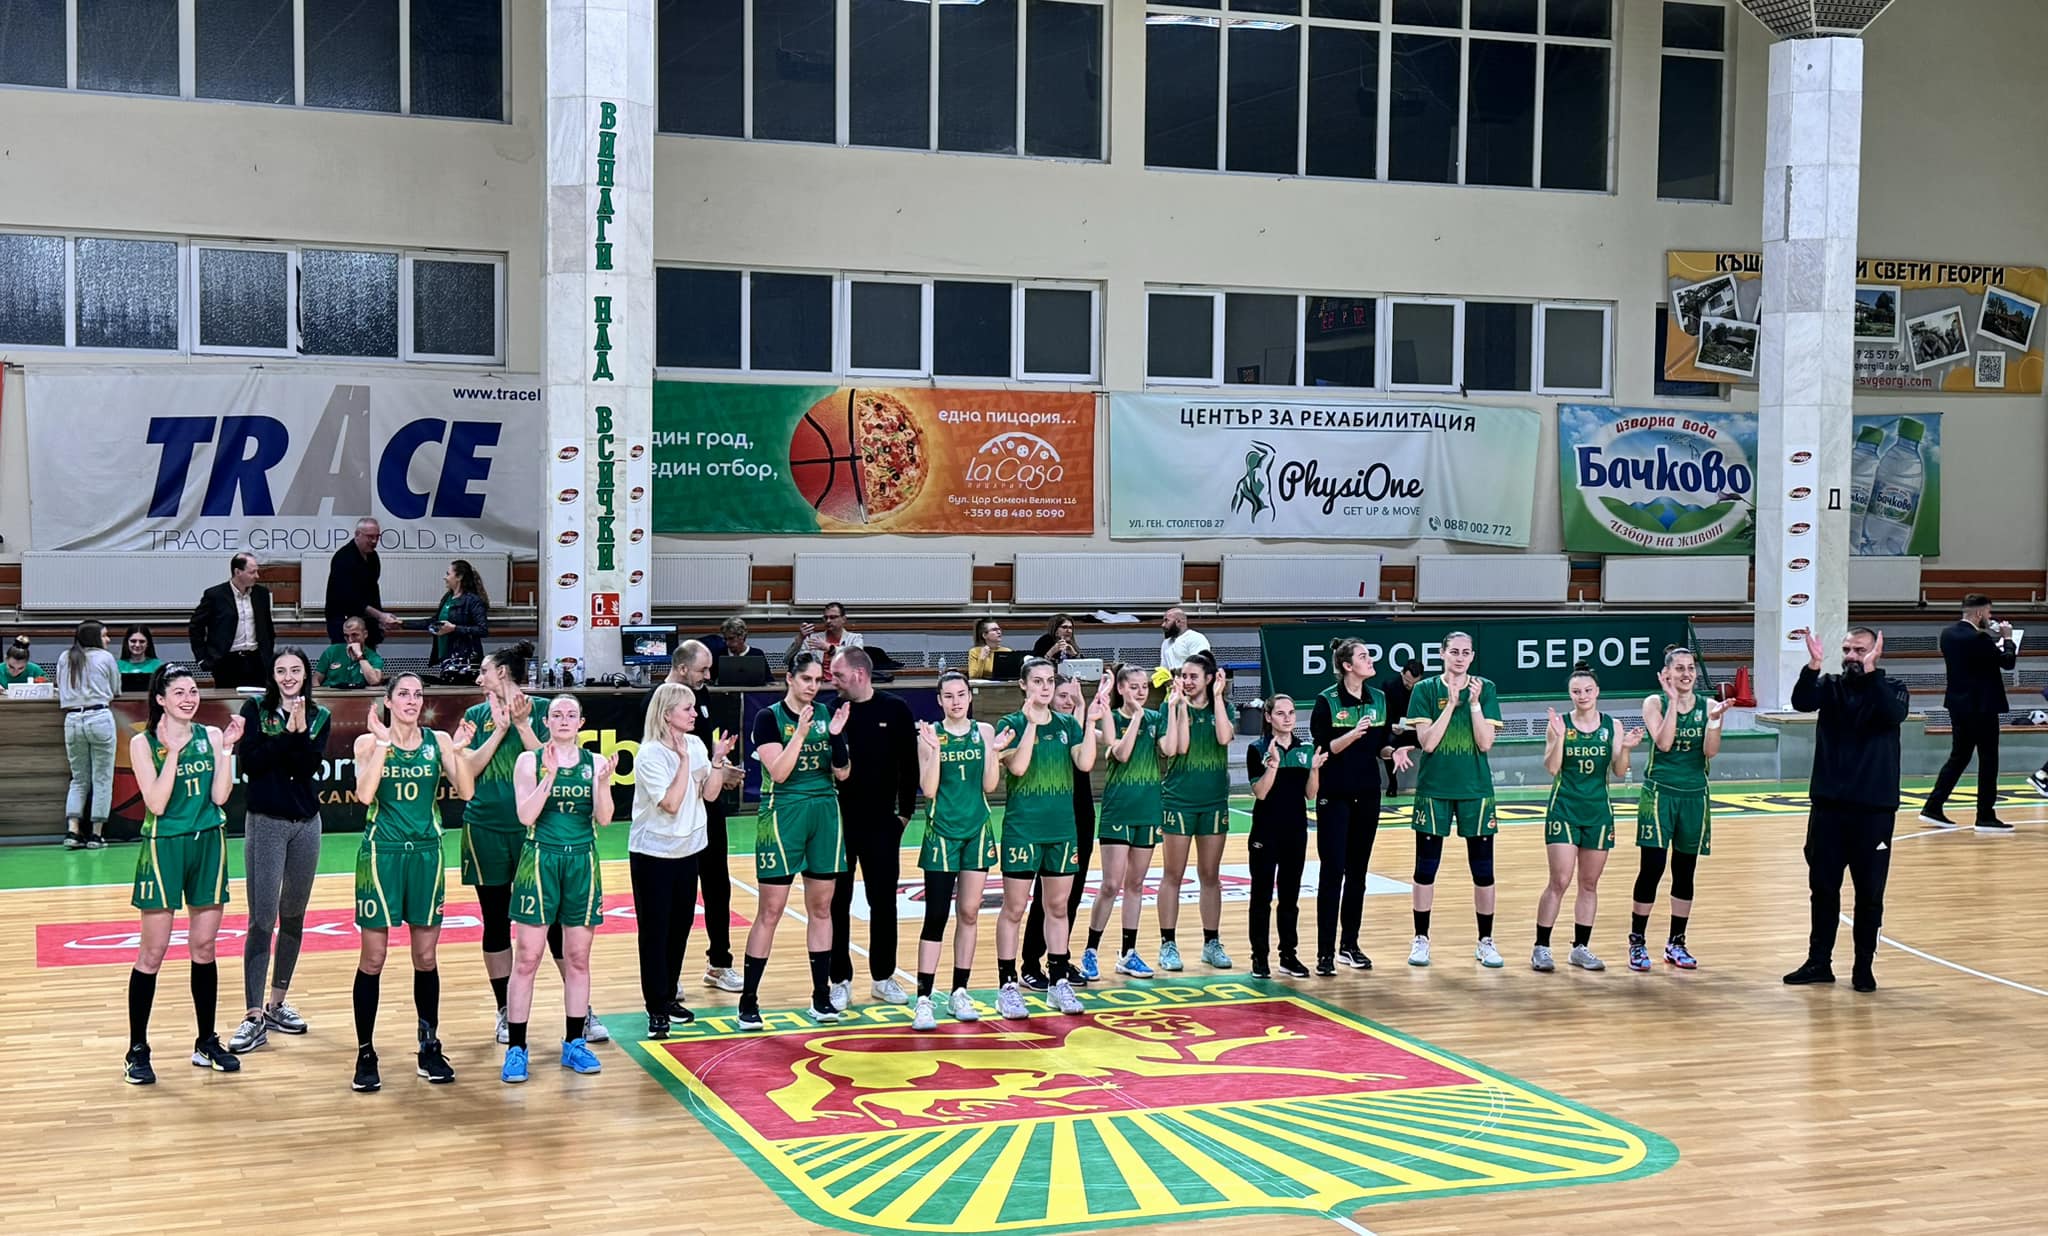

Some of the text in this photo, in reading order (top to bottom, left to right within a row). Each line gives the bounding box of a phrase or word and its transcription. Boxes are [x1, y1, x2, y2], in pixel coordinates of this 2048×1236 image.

[1874, 262, 1931, 281] СВЕТИ
[1937, 265, 2004, 285] ГЕОРГИ
[592, 102, 617, 571] ВИНАГИ НАД ВСИЧКИ
[938, 410, 981, 424] една
[1180, 408, 1476, 432] ЦЕНТЪР ЗА РЕХАБИЛИТАЦИЯ
[1616, 416, 1718, 439] изворна вода
[652, 431, 754, 450] дин град,
[146, 384, 502, 519] TRACE
[706, 458, 778, 481] отбор,
[1577, 446, 1752, 494] Бачково
[1278, 459, 1424, 515] PhysiOne
[948, 495, 1077, 506] бул. Цар Симеон Велики 116
[963, 508, 1065, 518] +359 88 480 5090
[1343, 506, 1422, 516] GET UP & MOVE
[1129, 519, 1225, 528] УЛ. ГЕН. СТОЛЕТОВ 27
[1444, 519, 1512, 536] 0887 002 772
[149, 528, 485, 550] TRACE GROUP OLD PLC
[1609, 519, 1653, 547] избор
[1656, 535, 1674, 547] на
[1517, 636, 1651, 670] БЕРОЕ
[940, 749, 982, 762] BEROE
[1566, 746, 1607, 757] BEROE
[176, 759, 214, 777] EROE
[798, 755, 820, 771] 33
[1578, 759, 1595, 774] 19
[958, 764, 966, 781] 1
[185, 777, 200, 797] 11
[394, 781, 419, 800] 10
[552, 785, 591, 798] EROE
[1163, 810, 1176, 826] 14
[1548, 821, 1562, 836] 19
[1641, 824, 1653, 840] 13
[759, 852, 777, 869] 33
[1008, 847, 1029, 864] 34
[139, 880, 154, 900] 11
[357, 900, 378, 919] 10
[520, 895, 536, 915] 12
